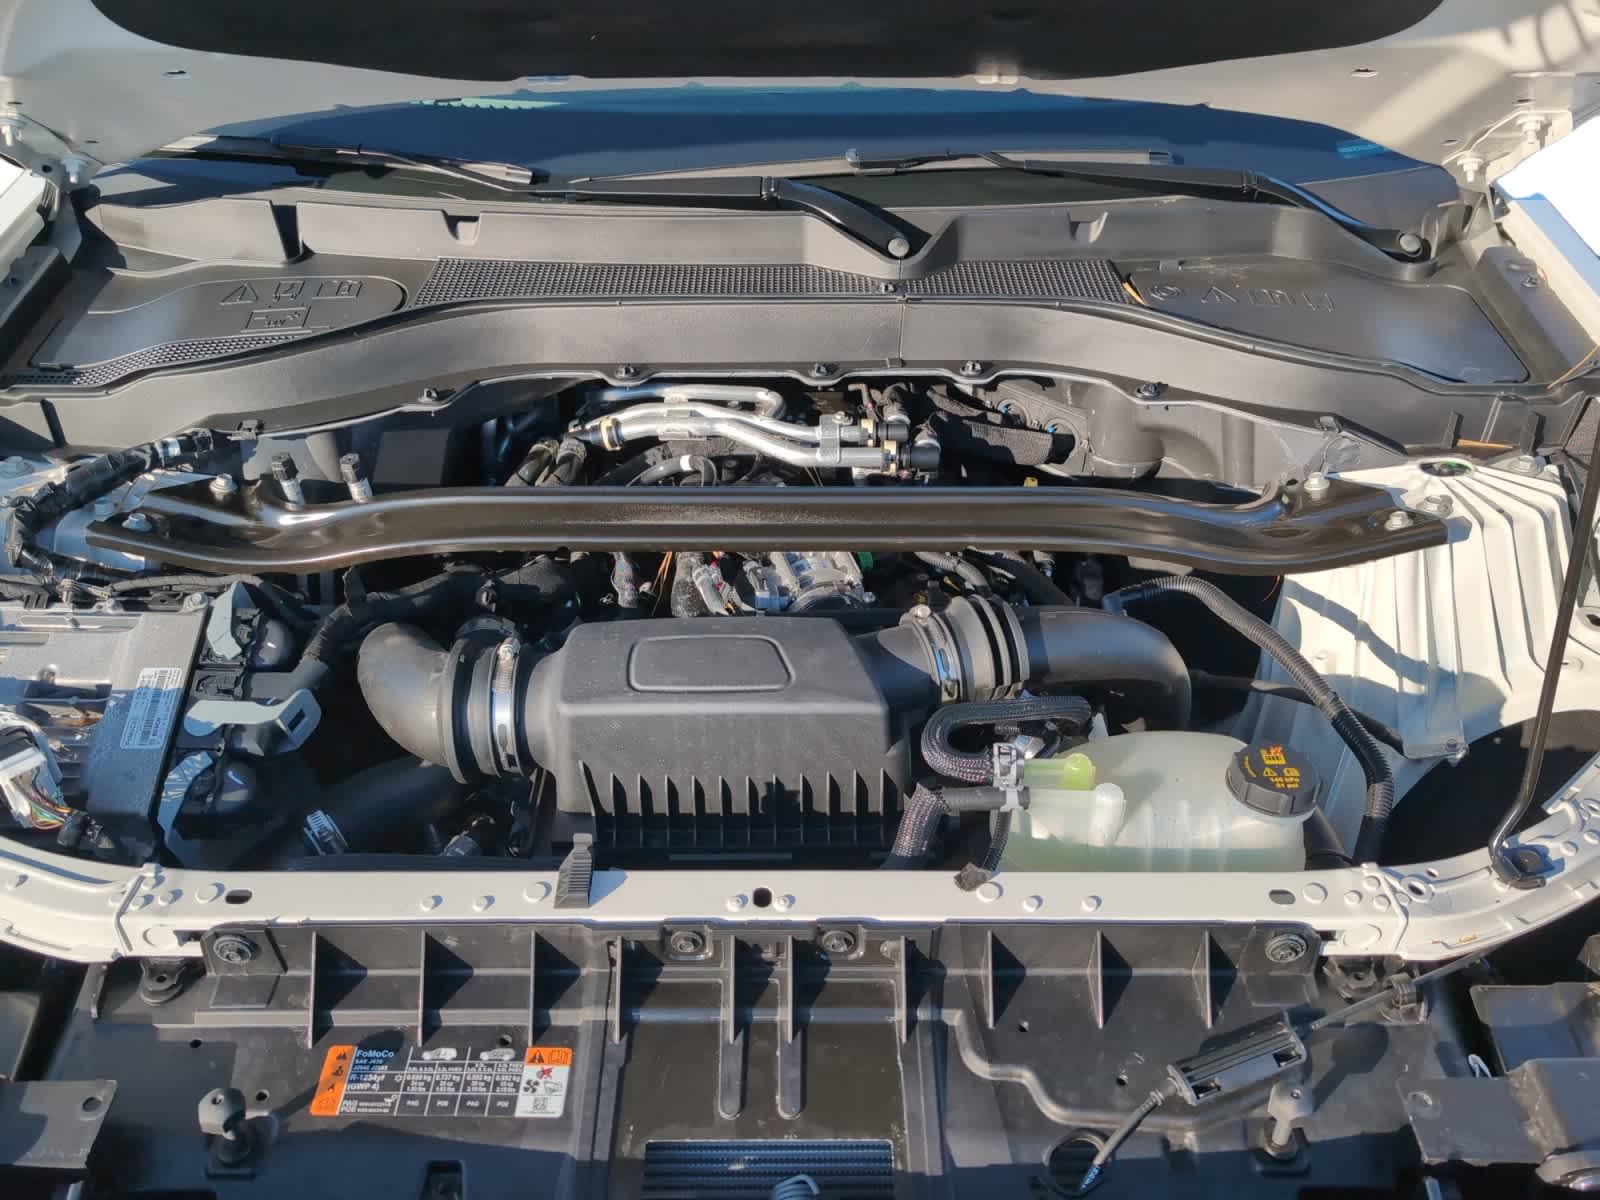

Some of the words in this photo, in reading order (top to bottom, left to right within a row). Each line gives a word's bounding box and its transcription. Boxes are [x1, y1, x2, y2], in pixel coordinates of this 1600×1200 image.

[356, 1050, 395, 1058] FoMoCo
[350, 1074, 385, 1082] R-1234yf
[371, 1083, 380, 1091] 4)
